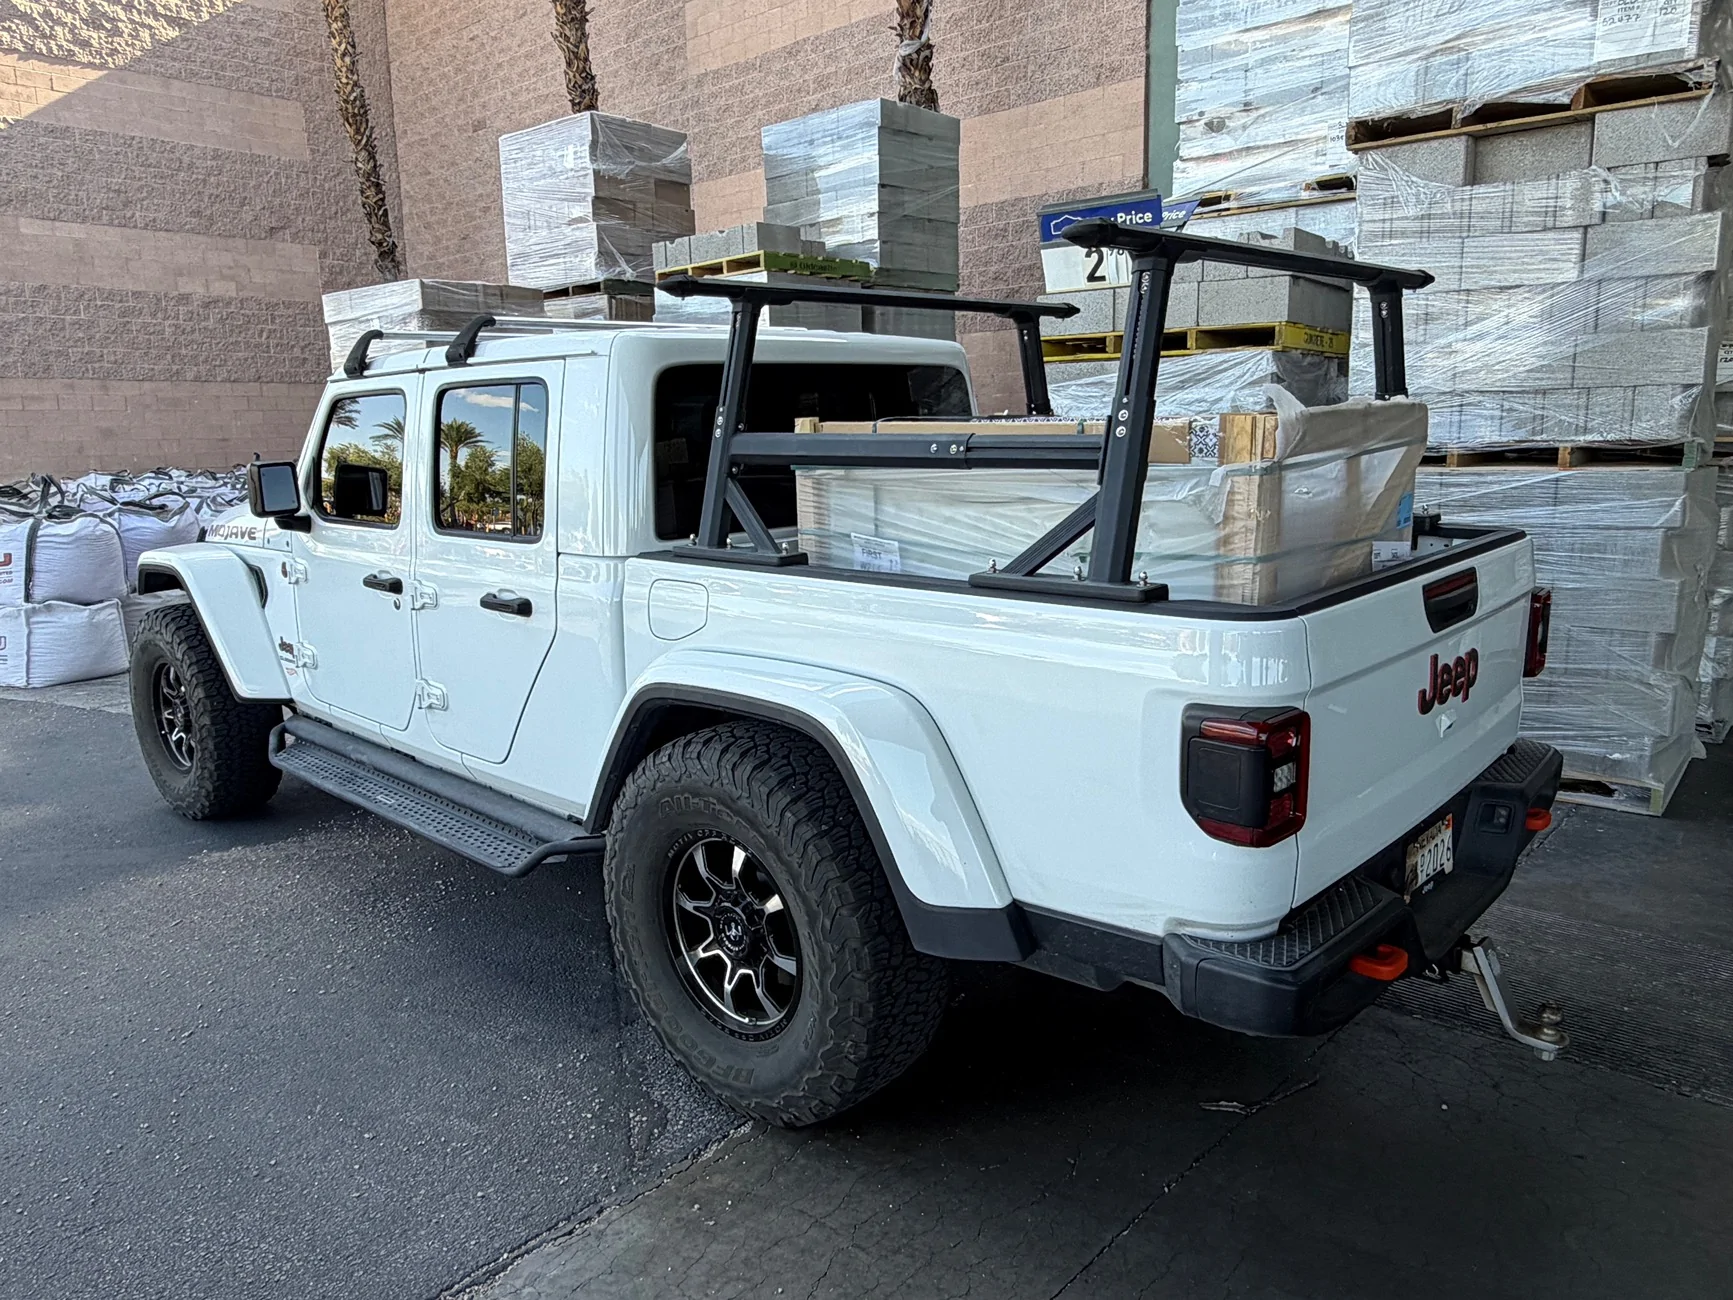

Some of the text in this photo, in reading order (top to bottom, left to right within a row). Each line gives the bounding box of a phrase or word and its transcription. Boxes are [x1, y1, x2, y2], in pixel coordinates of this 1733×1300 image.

[1659, 7, 1677, 16] 120
[1117, 210, 1152, 224] Price
[1162, 209, 1186, 220] Price
[1084, 248, 1106, 283] 2
[208, 524, 257, 541] MOJAVE
[1418, 647, 1478, 715] Jeep
